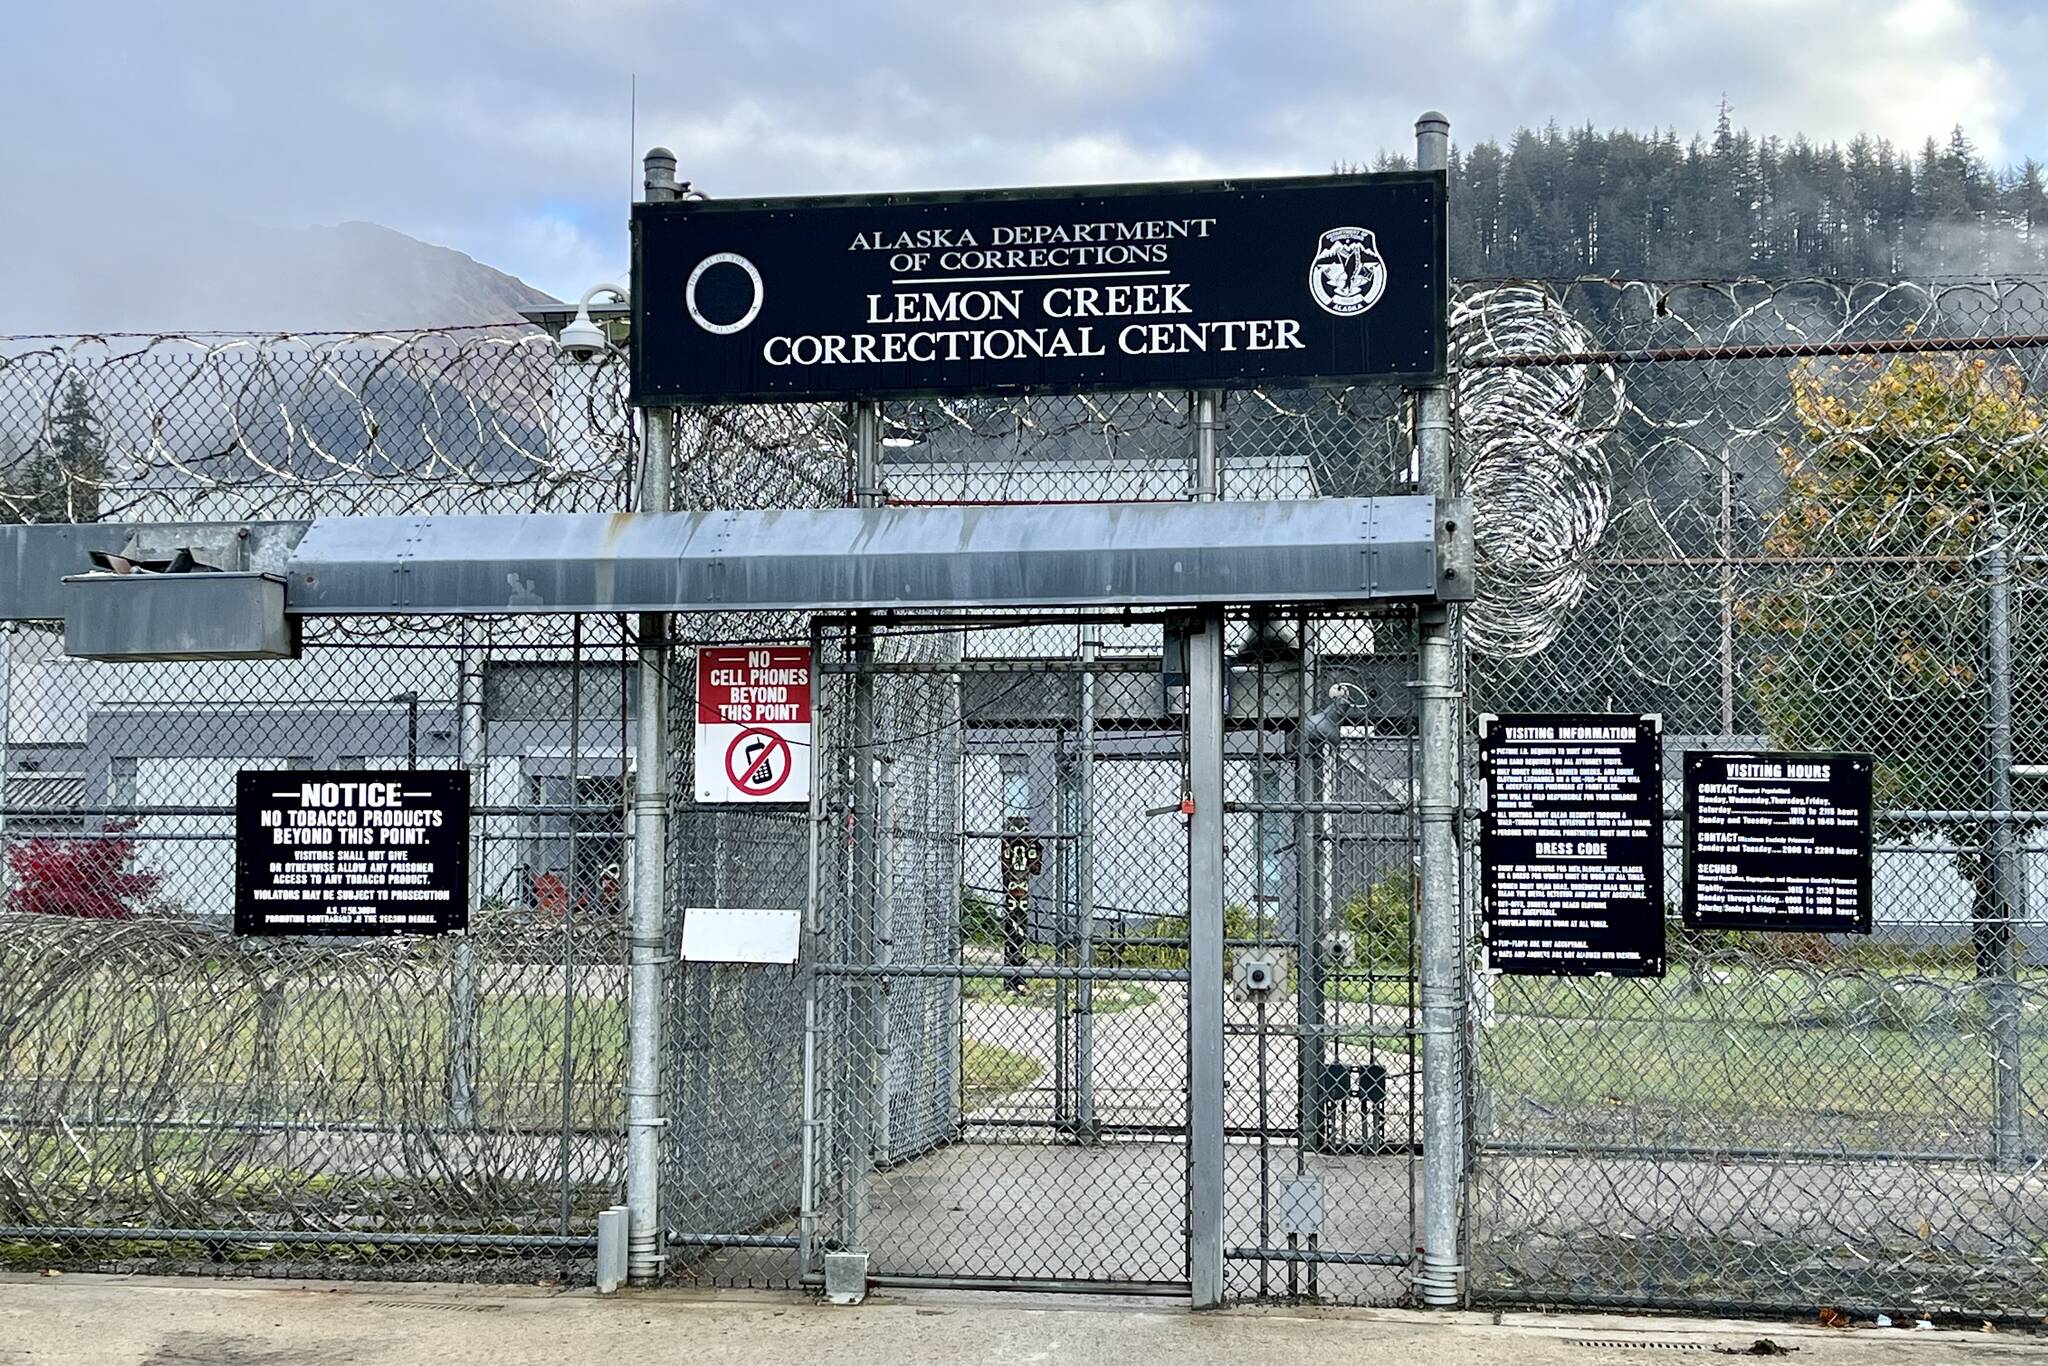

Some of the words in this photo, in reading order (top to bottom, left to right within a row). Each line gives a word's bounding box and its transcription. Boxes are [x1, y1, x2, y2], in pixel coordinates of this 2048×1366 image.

[848, 224, 978, 252] ALASKA
[992, 217, 1217, 246] DEPARTMENT
[889, 246, 933, 273] OF
[939, 242, 1168, 271] CORRECTIONS
[867, 288, 1022, 325] LEMON
[1042, 282, 1193, 317] CREEK
[763, 325, 1107, 366] CORRECTIONAL
[1119, 319, 1305, 356] CENTER
[748, 651, 770, 668] NO
[710, 669, 746, 686] CELL
[750, 668, 809, 686] PHONES
[730, 686, 788, 704] BEYOND
[718, 704, 752, 722] THIS
[755, 704, 799, 721] POINT
[1505, 727, 1554, 740] VISITING
[1558, 728, 1636, 740] INFORMATION
[1726, 764, 1782, 778] VISITING
[1786, 764, 1831, 778] HOURS
[301, 782, 402, 807] NOTICE
[1698, 783, 1737, 794] CONTACT
[260, 810, 281, 826] NO
[289, 809, 356, 826] TOBACCO
[363, 809, 442, 826] PRODUCTS
[1698, 815, 1724, 824] Sunday
[1742, 816, 1772, 825] Tuesday
[273, 828, 332, 844] BEYOND
[340, 828, 373, 844] THIS
[380, 828, 429, 844] POINT.
[1697, 832, 1737, 842] CONTACT
[1535, 842, 1572, 854] DRESS
[1577, 842, 1607, 855] CODE
[1697, 843, 1724, 852] Sunday
[1742, 844, 1772, 853] Tuesday
[294, 850, 334, 860] VISITORS
[337, 850, 363, 860] SHALL
[367, 850, 384, 860] NOT
[387, 850, 408, 860] GIVE
[269, 862, 282, 872] OR
[284, 862, 334, 872] OTHERWISE
[337, 862, 366, 872] ALLOW
[370, 862, 387, 872] ANY
[390, 862, 433, 873] PRISONER
[1697, 863, 1737, 874] SECURED
[272, 874, 307, 884] ACCESS
[310, 874, 321, 884] TO
[324, 874, 342, 884] ANY
[346, 874, 385, 884] TOBACCO
[253, 889, 300, 900] VIOLATORS
[302, 890, 320, 900] MAY
[322, 890, 334, 900] BE
[336, 890, 374, 900] SUBJECT
[377, 890, 388, 900] TO
[390, 890, 449, 900] PROSECUTION
[1697, 884, 1723, 892] Nightly
[1697, 893, 1725, 902] Monday
[1726, 894, 1755, 903] through
[1836, 907, 1856, 915] hours
[364, 915, 377, 923] THE
